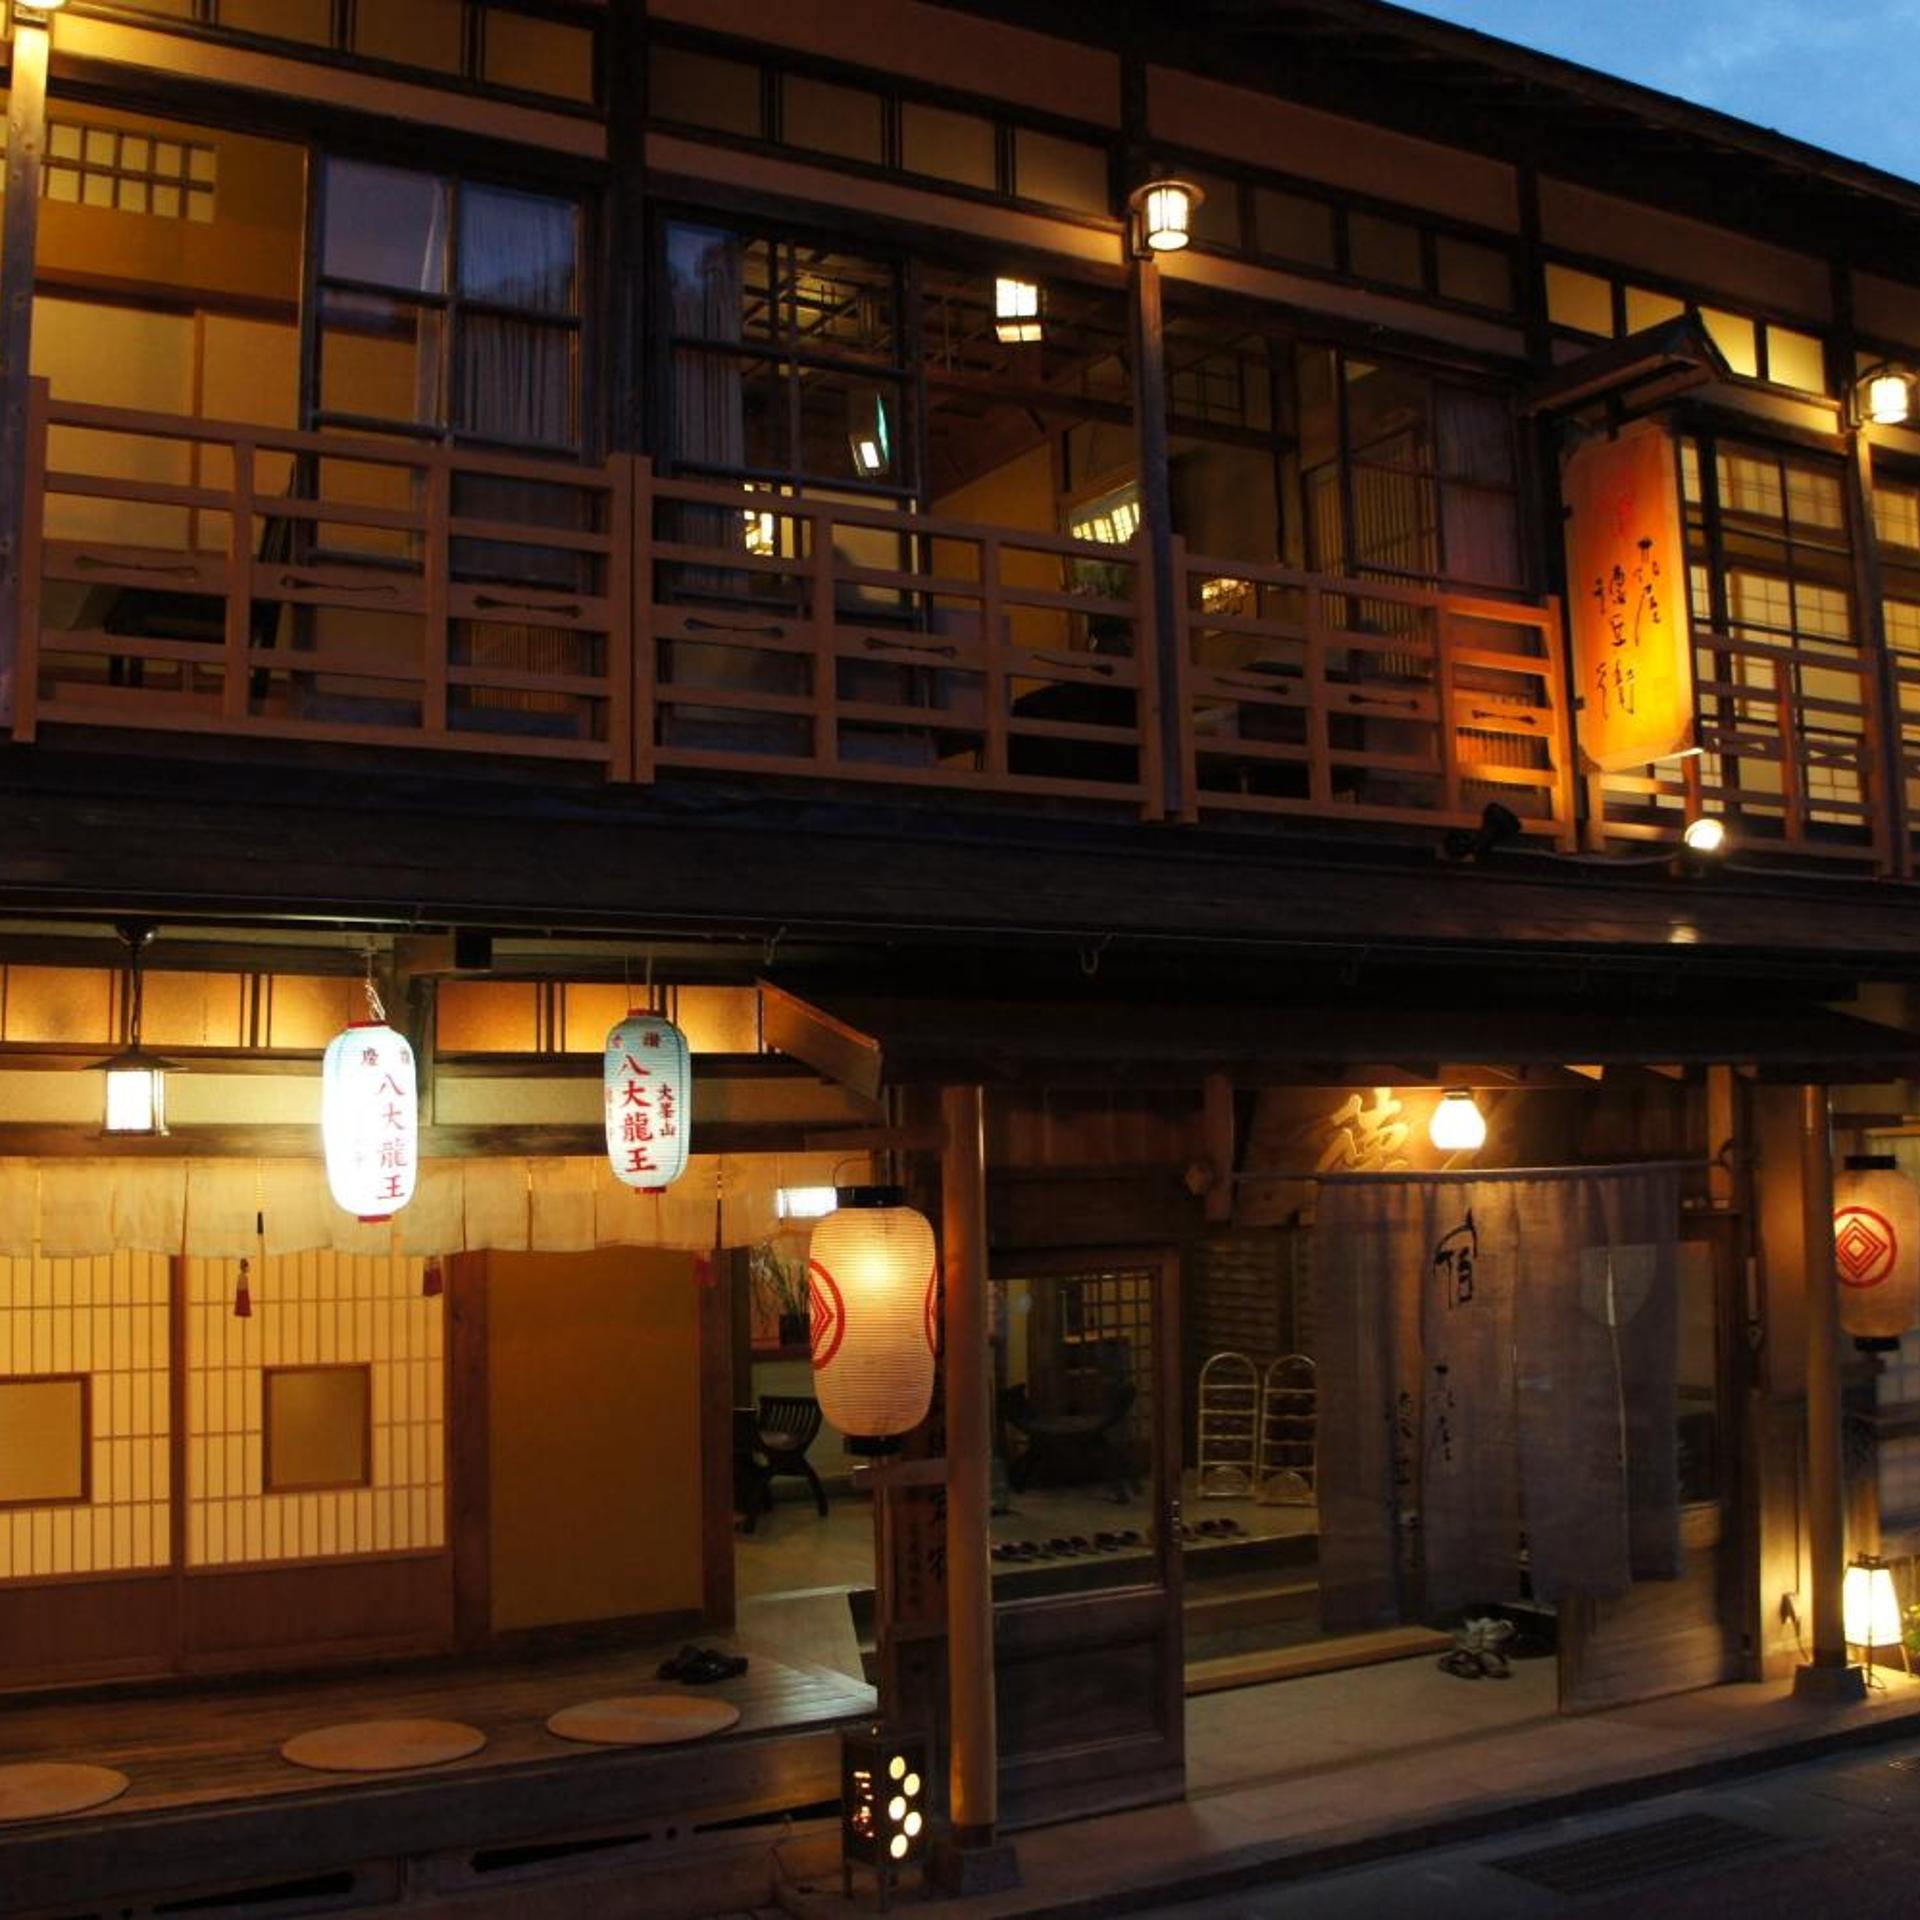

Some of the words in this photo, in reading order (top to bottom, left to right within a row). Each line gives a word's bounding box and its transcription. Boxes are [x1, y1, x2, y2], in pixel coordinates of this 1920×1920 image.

[376, 1072, 409, 1200] 八大龍王
[617, 1053, 657, 1173] 八大龍王
[1433, 1209, 1477, 1310] 宿
